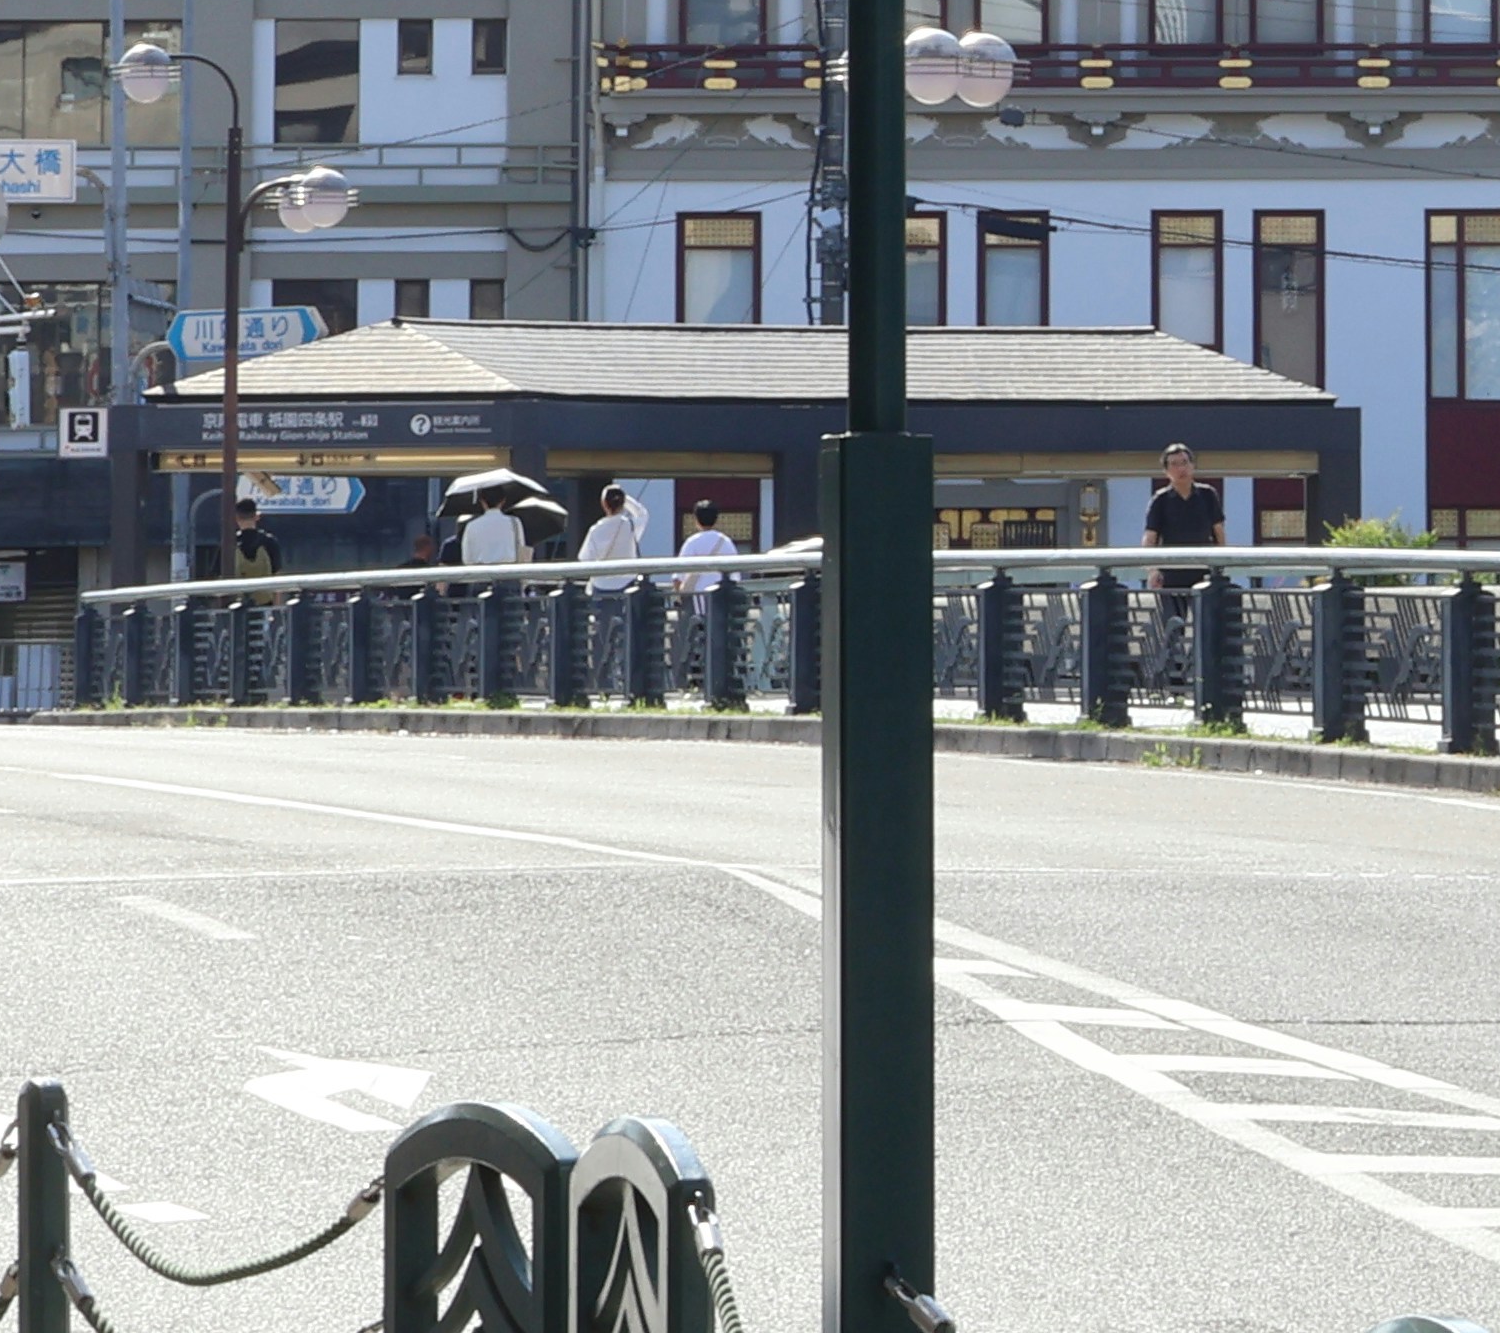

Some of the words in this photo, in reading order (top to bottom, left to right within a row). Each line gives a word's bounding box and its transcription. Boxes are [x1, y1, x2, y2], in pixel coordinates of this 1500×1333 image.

[262, 339, 283, 351] dori
[239, 431, 277, 442] Railway
[332, 430, 368, 440] Station
